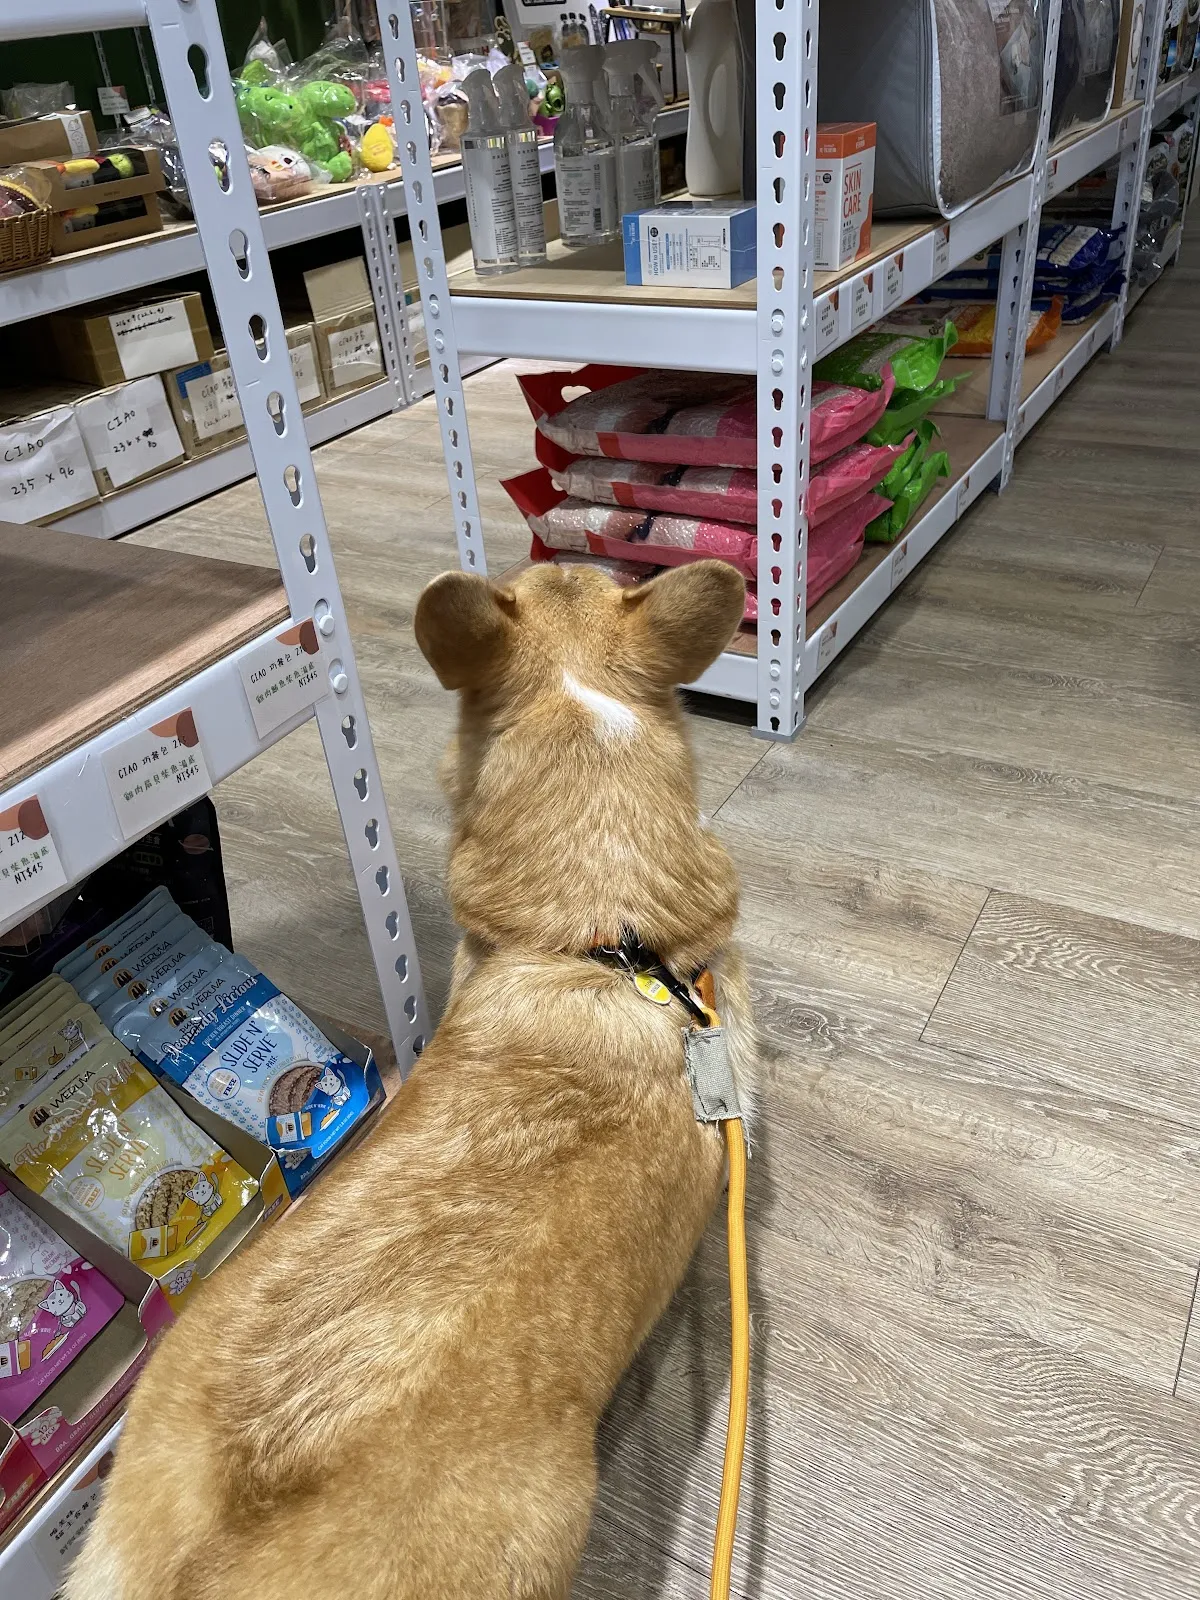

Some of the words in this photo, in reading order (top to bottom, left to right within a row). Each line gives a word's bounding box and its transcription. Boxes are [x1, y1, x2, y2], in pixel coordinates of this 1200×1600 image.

[844, 168, 862, 195] SKIN
[844, 192, 862, 218] CARE
[107, 410, 136, 431] CIAO
[4, 439, 44, 462] CIAO
[11, 478, 35, 496] 235
[59, 466, 75, 479] 96
[250, 668, 267, 684] CIAO
[298, 670, 318, 687] NT$45
[118, 762, 138, 779] CIAO
[176, 764, 199, 784] NT$45
[14, 861, 44, 884] NT$45
[132, 940, 173, 973] WERUVA
[146, 952, 186, 984] WERUVA
[167, 968, 208, 1001] WERUVA
[186, 978, 227, 1011] WERUVA
[242, 1035, 277, 1073] SERVE
[50, 1070, 97, 1109] WERUVA
[223, 1078, 237, 1096] FREE
[108, 1140, 149, 1180] SERVE
[36, 1377, 45, 1386] CAT
[43, 1366, 55, 1378] FOOD
